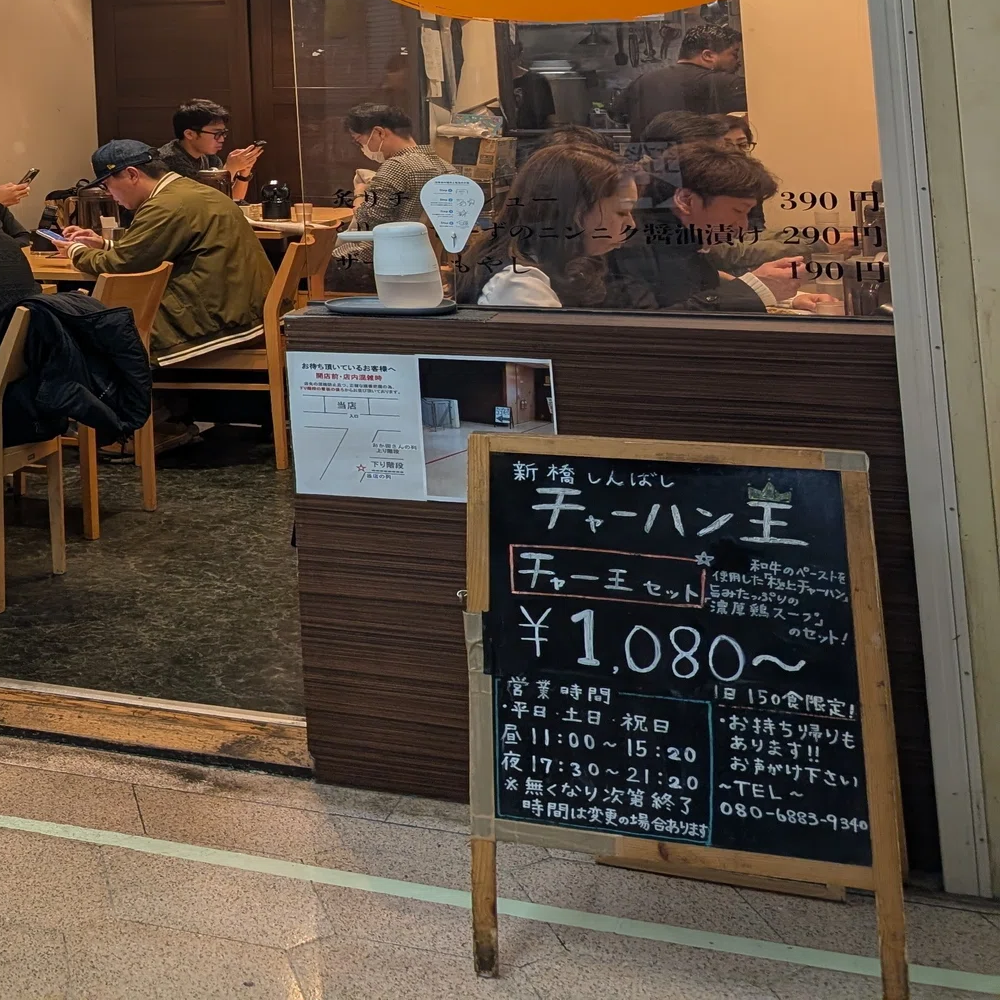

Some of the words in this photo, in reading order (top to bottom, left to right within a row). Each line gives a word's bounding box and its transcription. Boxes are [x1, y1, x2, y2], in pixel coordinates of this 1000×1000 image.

[302, 363, 396, 372] お待ち頂いているお客様へ
[337, 402, 356, 410] 当店
[371, 461, 404, 469] 下り階段
[532, 487, 809, 546] チャーハン王
[750, 559, 846, 584] 和牛のペーストを
[709, 584, 799, 606] 旨みたっぷりの
[788, 627, 848, 645] のセット!
[507, 676, 611, 705] 営業時間
[730, 756, 858, 787] お声がけ下さい
[522, 798, 708, 839] 時間は変更の場合あります
[720, 802, 868, 833] 080-6883-9340
